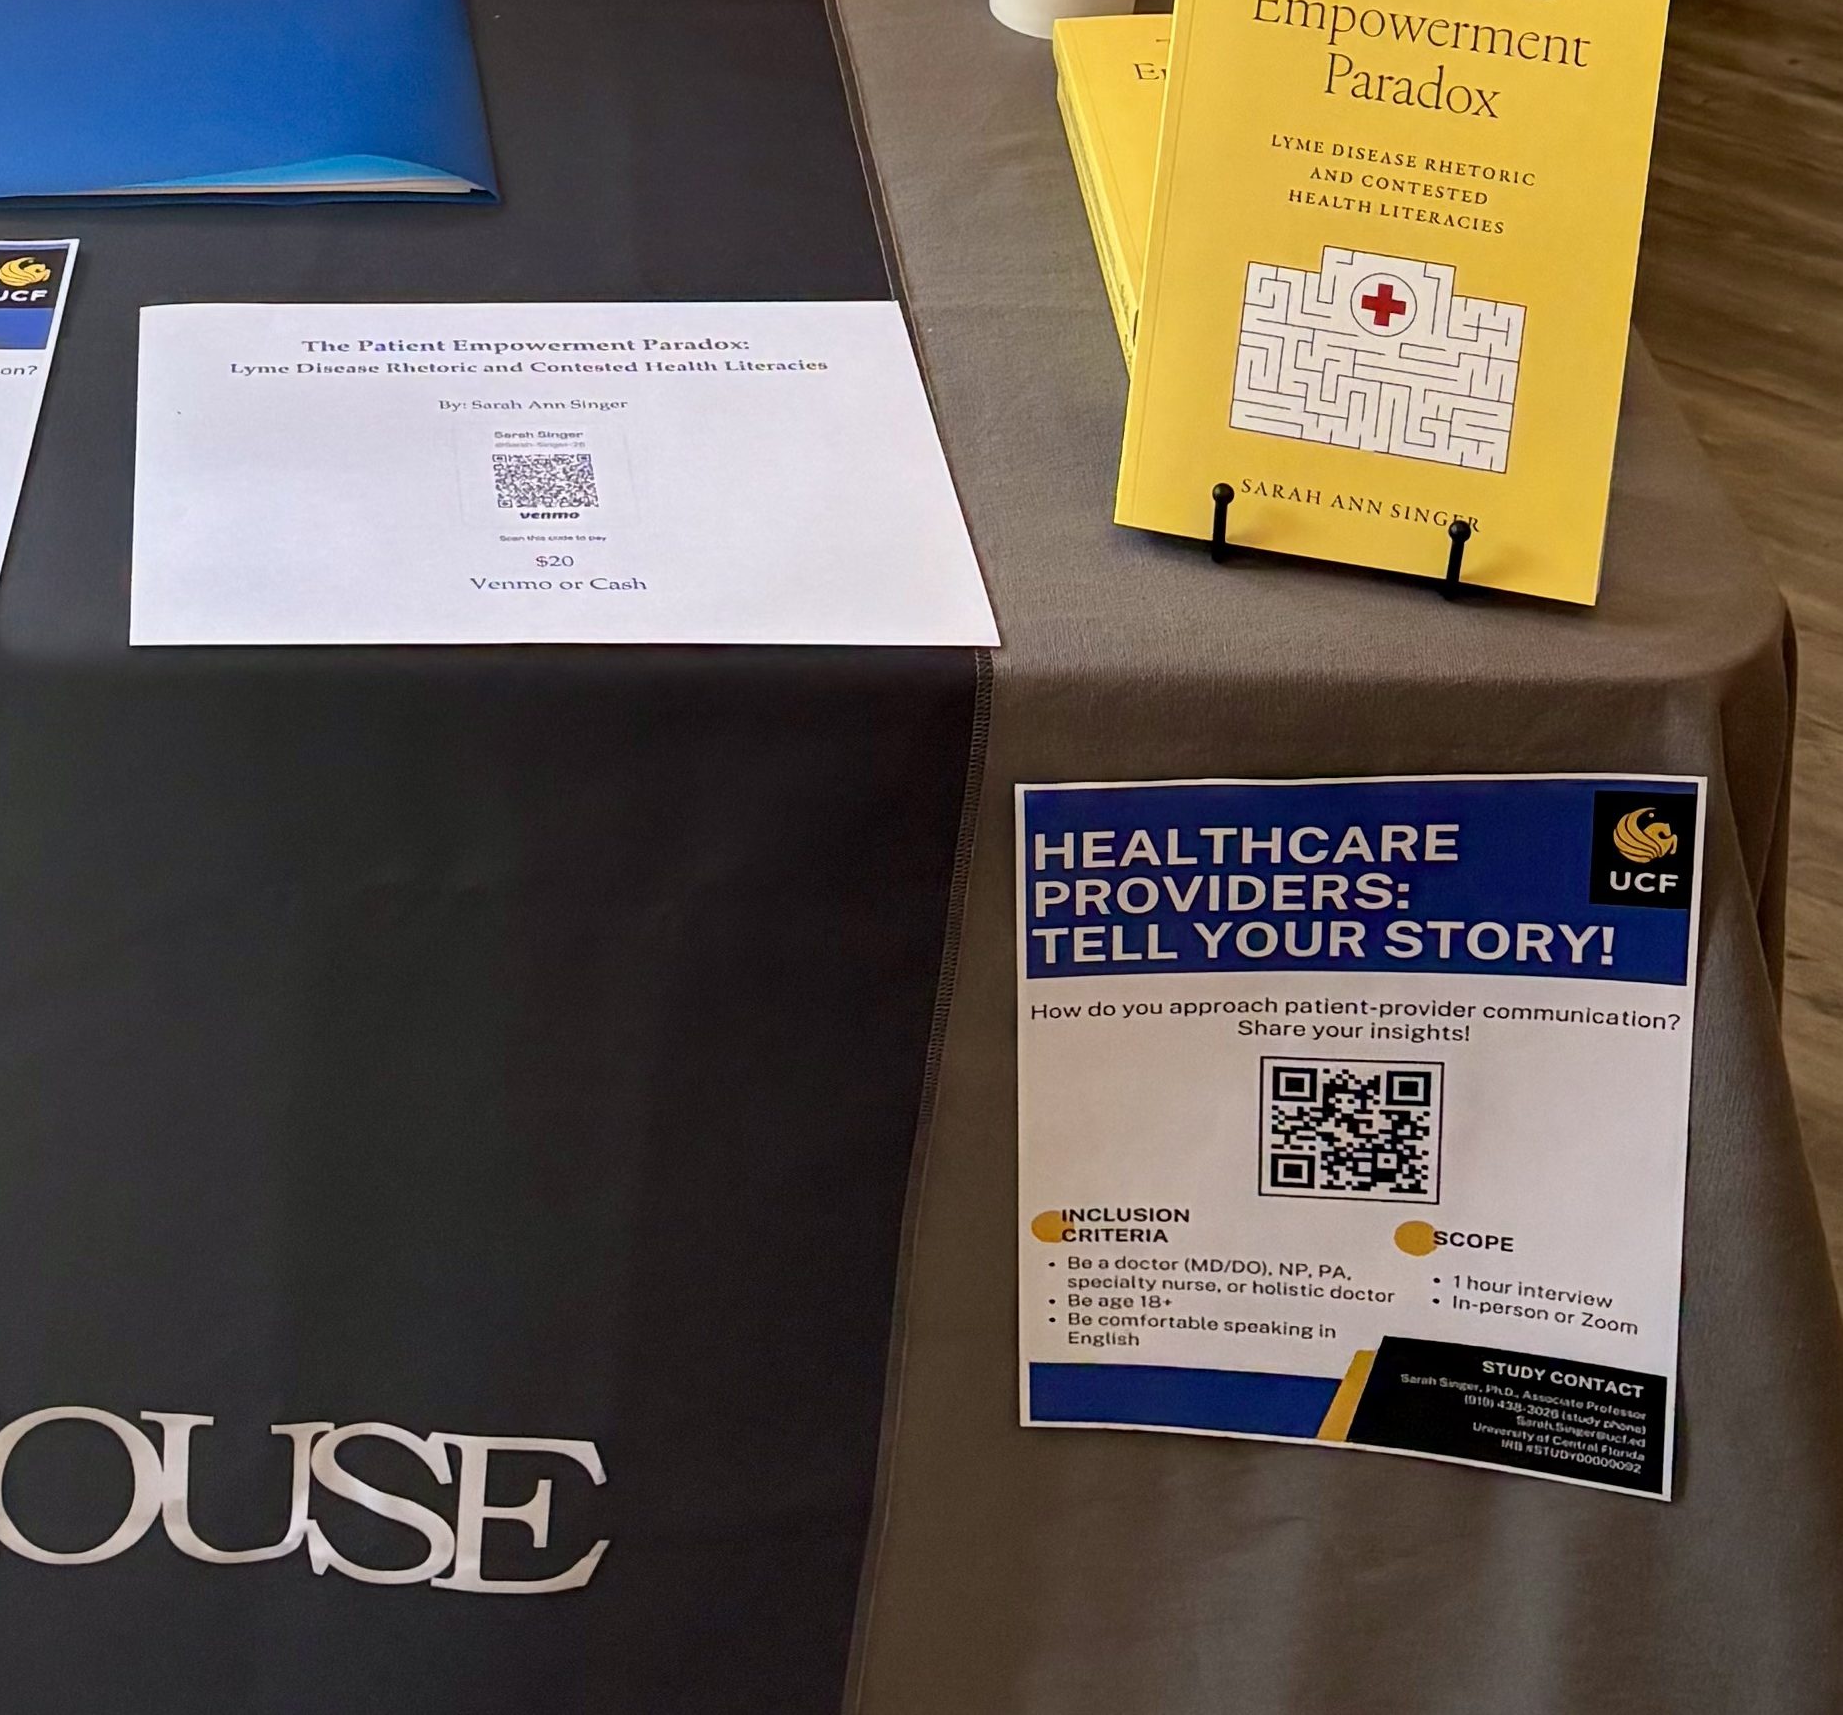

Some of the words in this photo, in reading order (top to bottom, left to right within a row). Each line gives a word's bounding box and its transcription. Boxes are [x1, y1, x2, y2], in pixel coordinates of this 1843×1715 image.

[1322, 53, 1501, 120] Paradox
[1271, 134, 1325, 156] LYME
[1331, 143, 1417, 172] DISEASE
[1425, 157, 1537, 187] RHETORIC
[1311, 167, 1353, 186] AND
[1362, 172, 1488, 206] CONTESTED
[1288, 189, 1373, 216] HEALTH
[1381, 201, 1505, 236] LITERACIES
[301, 340, 349, 353] The
[358, 340, 443, 353] Patient
[452, 338, 635, 356] Empowerment
[643, 338, 750, 353] Paradox:
[230, 362, 290, 376] Lyme
[297, 362, 379, 374] Disease
[387, 362, 474, 374] Rhetoric
[483, 362, 522, 374] and
[531, 360, 637, 374] Contested
[644, 360, 719, 373] Health
[725, 359, 827, 372] Literacies
[438, 400, 467, 412] By:
[472, 399, 522, 410] Sarah
[529, 399, 566, 409] Ann
[571, 398, 628, 412] Singer
[538, 431, 583, 439] Singer
[1242, 478, 1321, 505] SARAH
[1331, 494, 1382, 515] ANN
[536, 556, 574, 567] $20
[470, 578, 552, 590] Venmo
[559, 580, 583, 590] or
[590, 577, 647, 590] Cash
[1033, 823, 1460, 872] HEALTHCARE
[1609, 870, 1679, 894] UCF
[1034, 874, 1409, 918] PROVIDERS:
[1032, 926, 1178, 965] TELL
[1194, 921, 1365, 961] YOUR
[1384, 921, 1616, 966] STORY!
[1031, 1004, 1082, 1021] How
[1088, 1002, 1116, 1018] do
[1122, 1001, 1162, 1021] you
[1169, 998, 1278, 1021] approach
[1285, 998, 1476, 1021] patient-provider
[1482, 1005, 1680, 1030] communication?
[1237, 1021, 1305, 1038] Share
[1312, 1024, 1364, 1042] your
[1370, 1021, 1471, 1043] insights!
[1061, 1208, 1190, 1224] INCLUSION
[1061, 1228, 1169, 1244] CRITERIA
[1433, 1230, 1514, 1253] SCOPE
[1067, 1256, 1091, 1270] Be
[1097, 1259, 1108, 1270] a
[1114, 1257, 1176, 1272] doctor
[1067, 1274, 1157, 1292] specialty
[1162, 1280, 1223, 1295] nurse,
[1229, 1283, 1247, 1295] or
[1252, 1280, 1324, 1298] holistic
[1330, 1287, 1395, 1305] doctor
[1067, 1293, 1091, 1308] Be
[1097, 1297, 1135, 1311] age
[1141, 1296, 1172, 1309] 18+
[1453, 1275, 1460, 1288] 1
[1466, 1278, 1512, 1296] hour
[1517, 1283, 1613, 1309] interview
[1067, 1313, 1091, 1327] Be
[1097, 1315, 1217, 1332] comfortable
[1223, 1320, 1313, 1341] speaking
[1319, 1325, 1336, 1340] in
[1451, 1298, 1547, 1322] In-person
[1553, 1308, 1574, 1323] or
[1581, 1314, 1638, 1336] Zoom
[1067, 1331, 1139, 1350] English
[1482, 1360, 1545, 1383] STUDY
[1550, 1371, 1644, 1398] CONTACT
